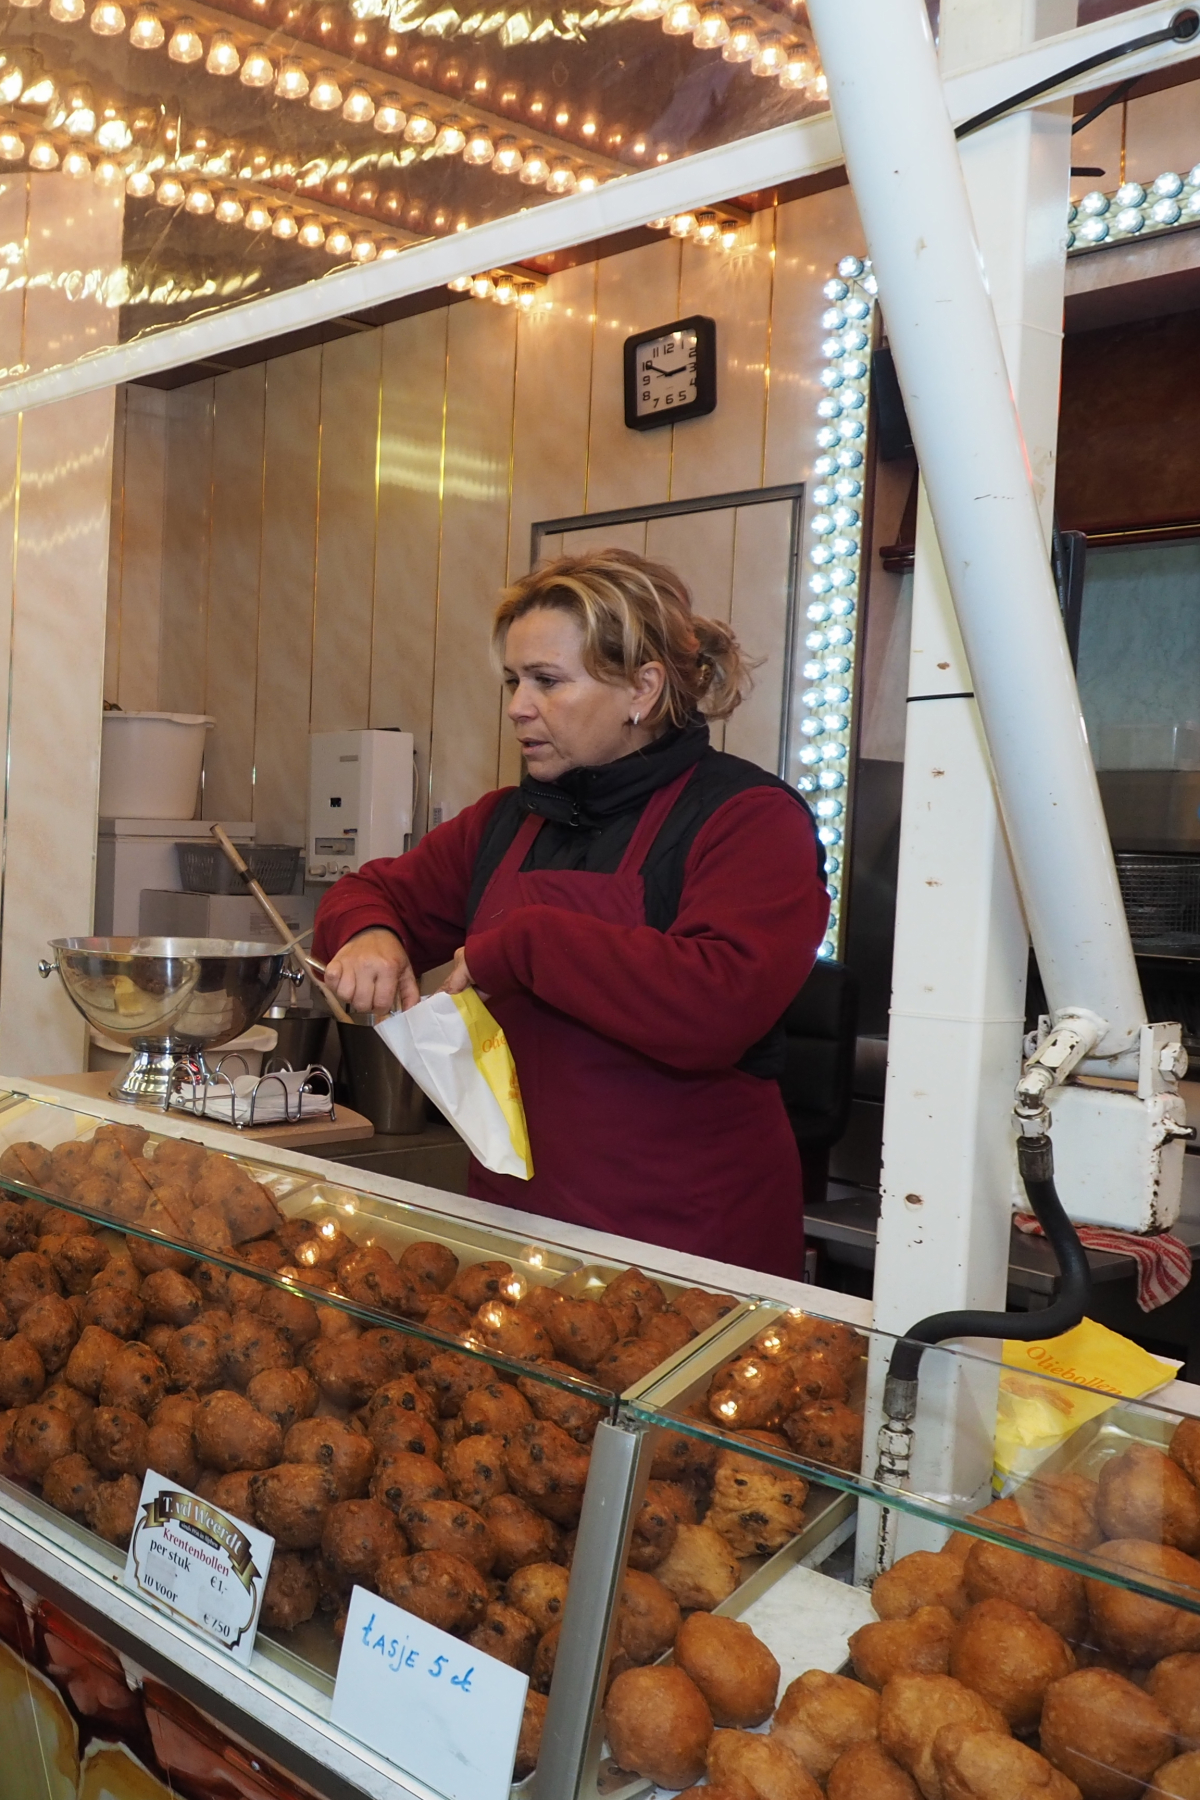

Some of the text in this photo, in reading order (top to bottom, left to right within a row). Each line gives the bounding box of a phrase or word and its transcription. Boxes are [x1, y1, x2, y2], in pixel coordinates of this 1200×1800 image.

[653, 347, 659, 358] 11
[664, 343, 675, 355] 12
[689, 347, 697, 358] 2
[643, 361, 653, 372] 10
[690, 362, 697, 373] 3
[643, 376, 651, 386] 9
[643, 391, 651, 401] 8
[666, 394, 674, 405] 6
[679, 390, 687, 402] 5
[653, 398, 660, 409] 7
[1026, 1345, 1123, 1395] Oliebollen
[162, 1496, 243, 1556] T. vd Weerdt
[150, 1539, 168, 1556] per
[167, 1550, 192, 1573] stuk
[162, 1527, 230, 1578] Krentenbollen
[143, 1574, 154, 1587] 10
[155, 1581, 179, 1603] voor
[427, 1655, 450, 1678] 5
